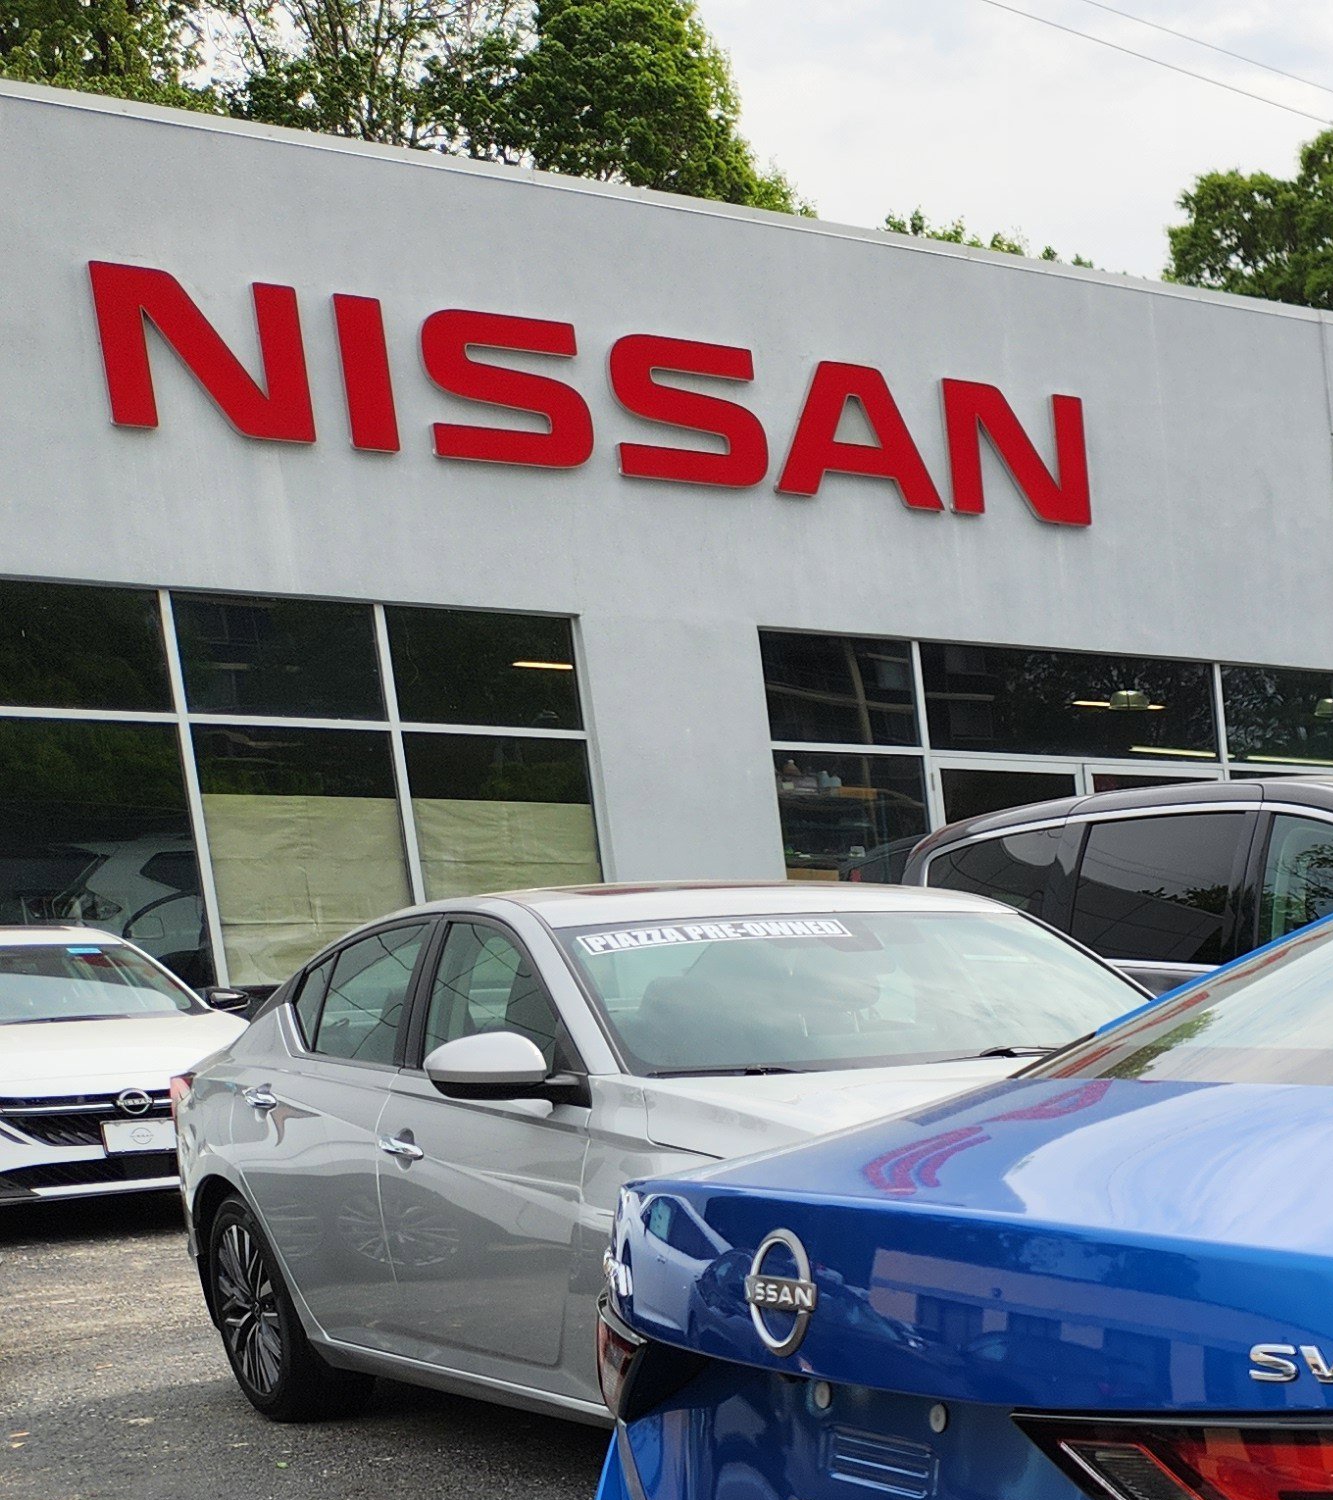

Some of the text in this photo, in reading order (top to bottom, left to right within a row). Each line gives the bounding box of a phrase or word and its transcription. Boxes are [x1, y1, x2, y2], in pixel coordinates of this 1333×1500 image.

[88, 259, 1092, 527] NISSAN
[585, 920, 843, 951] PIAZZA PRE-OWNED
